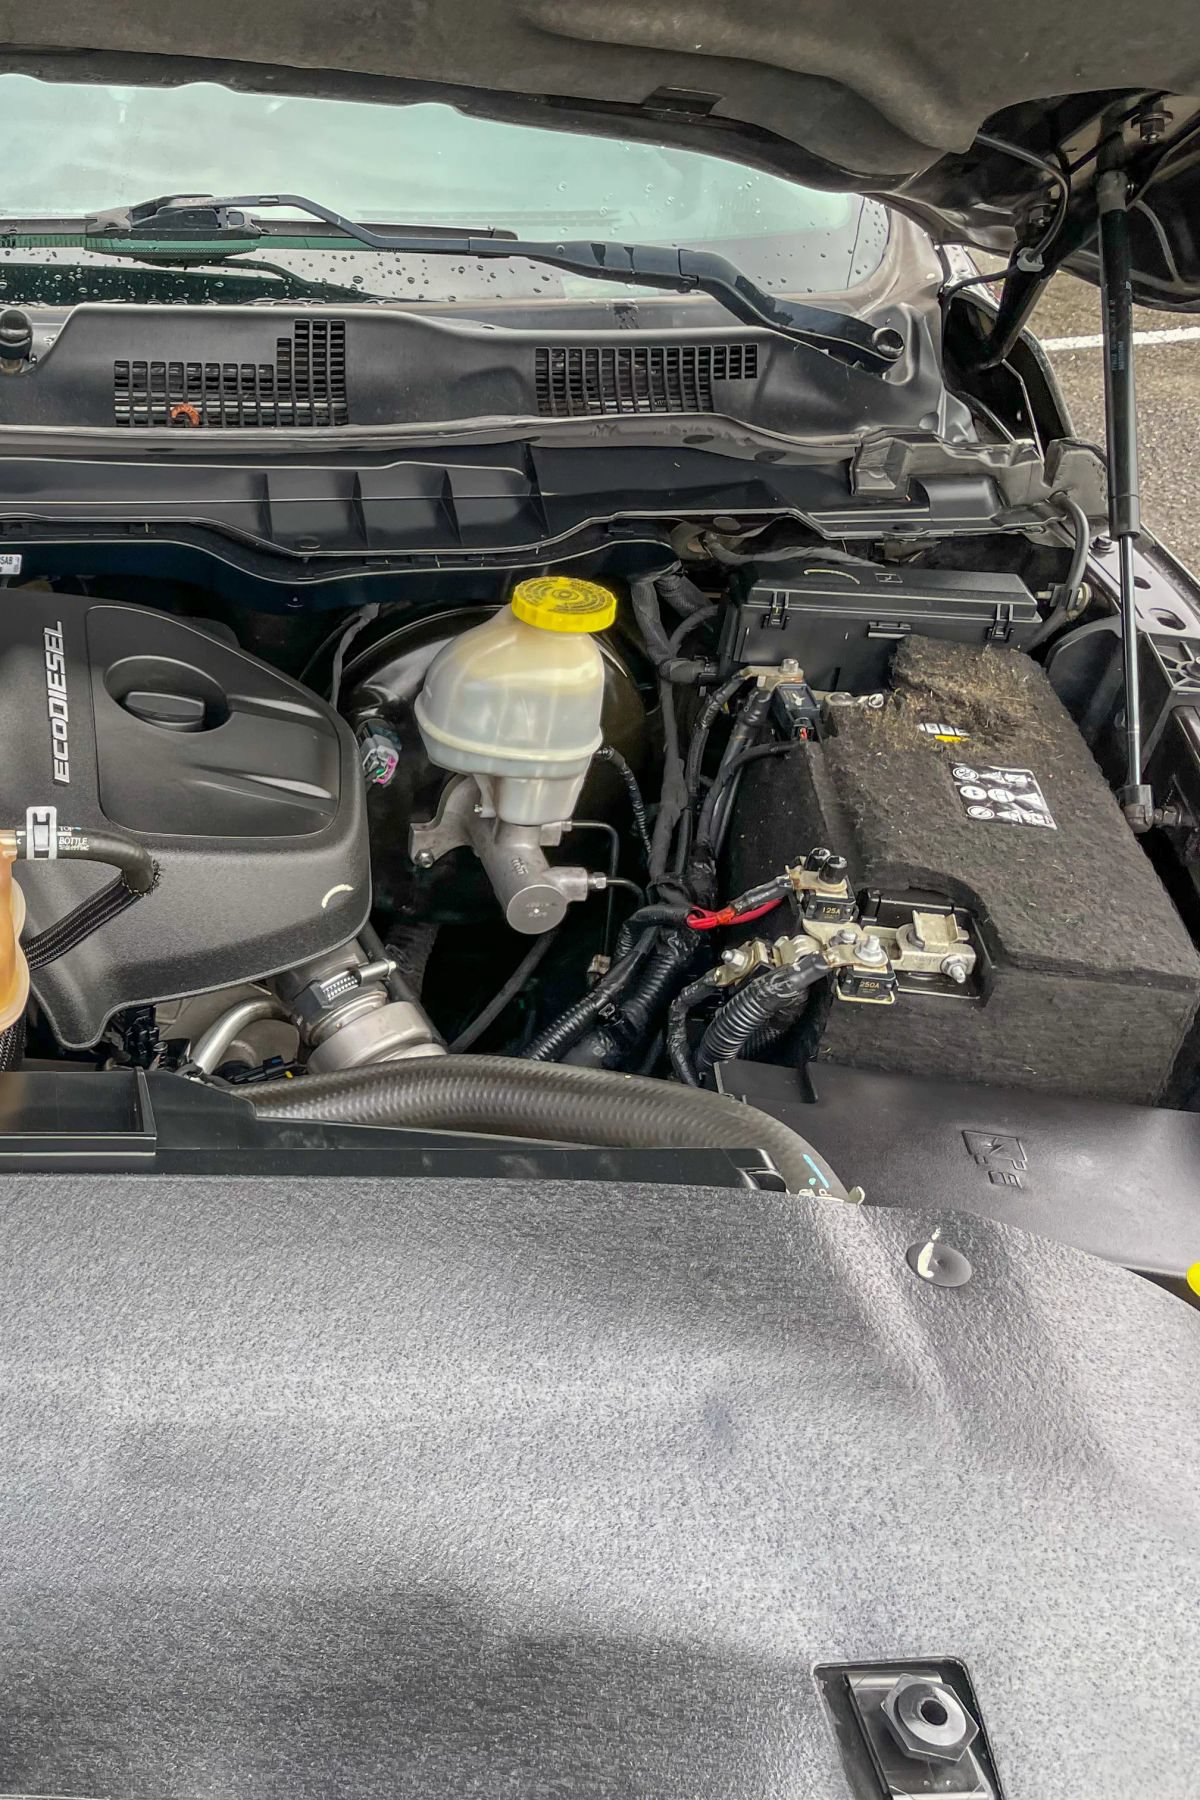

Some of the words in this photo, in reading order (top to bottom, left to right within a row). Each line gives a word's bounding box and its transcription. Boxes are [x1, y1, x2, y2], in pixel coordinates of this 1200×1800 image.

[43, 620, 71, 783] ECODIESEL
[58, 837, 88, 845] BOTTLE
[822, 906, 841, 915] 125A
[859, 981, 880, 989] 250A
